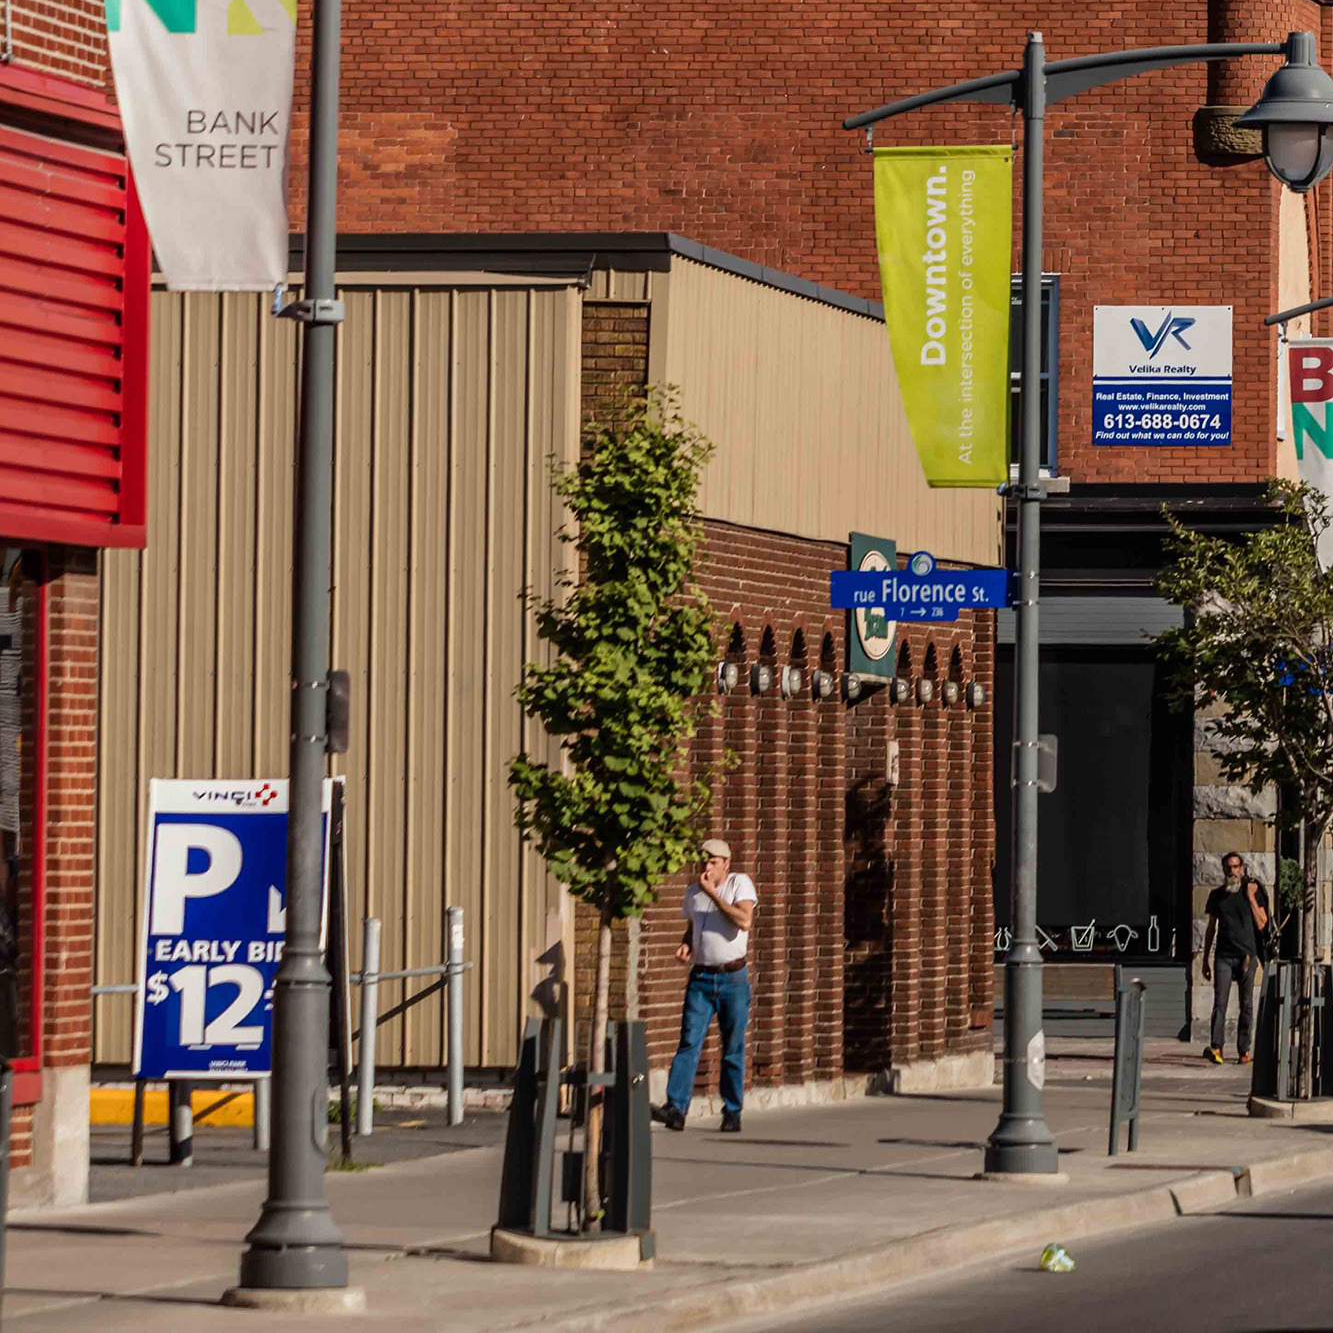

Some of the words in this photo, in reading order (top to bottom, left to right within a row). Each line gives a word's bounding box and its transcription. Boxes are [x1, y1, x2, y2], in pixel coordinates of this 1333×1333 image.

[187, 109, 280, 135] BANK
[154, 143, 279, 168] STREET
[958, 169, 976, 266] everything
[921, 165, 947, 365] Downtown.
[958, 269, 974, 289] of
[958, 294, 974, 402] intersection
[1129, 364, 1161, 374] Velika
[1164, 364, 1197, 375] Realty
[1095, 392, 1114, 401] Real
[1116, 392, 1145, 402] Estate,
[1146, 392, 1181, 402] Finance,
[1183, 392, 1229, 401] Investment
[1118, 403, 1206, 412] www.velikarealty.com
[958, 408, 974, 437] the
[1103, 413, 1221, 430] 613-688-0674
[1095, 431, 1114, 440] Find
[1115, 432, 1130, 440] out
[1131, 431, 1152, 440] what
[1183, 431, 1195, 440] do
[1196, 431, 1209, 440] for
[1209, 431, 1229, 441] you!
[958, 444, 974, 465] At
[853, 589, 876, 603] rue
[881, 577, 967, 603] Florence
[972, 585, 990, 603] St.
[150, 823, 244, 936] P
[154, 939, 242, 963] EARLY
